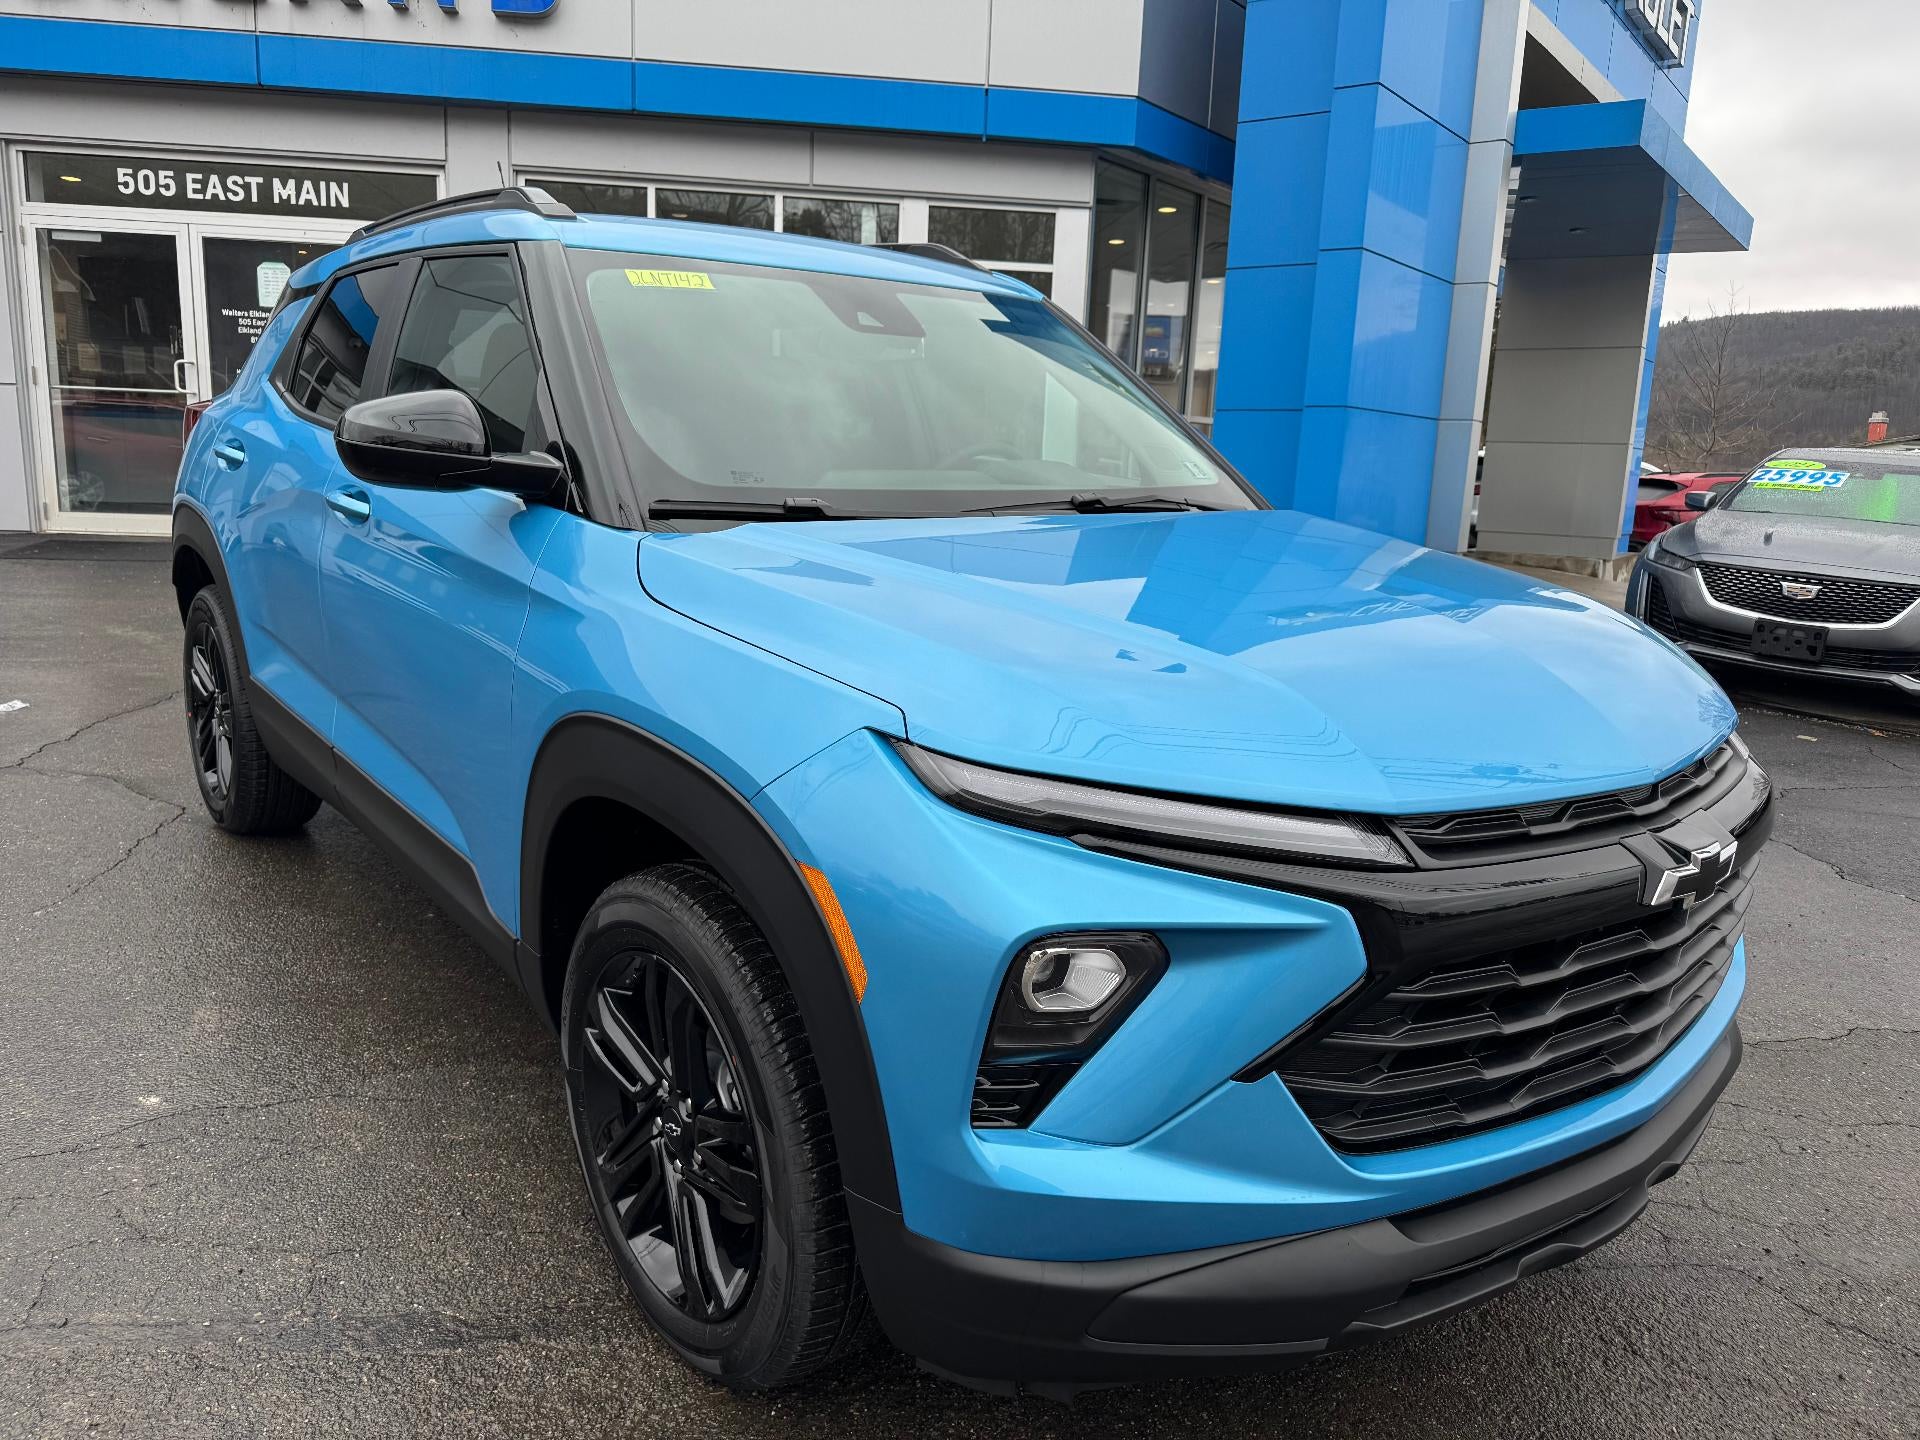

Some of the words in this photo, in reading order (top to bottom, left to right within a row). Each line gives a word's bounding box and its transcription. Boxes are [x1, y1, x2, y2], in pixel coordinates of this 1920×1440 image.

[116, 167, 177, 197] 505
[185, 172, 264, 203] EAST
[272, 177, 350, 208] MAIN
[221, 308, 248, 318] Walters
[249, 310, 270, 319] Elklan
[238, 318, 252, 326] 505
[1750, 469, 1845, 486] 25995
